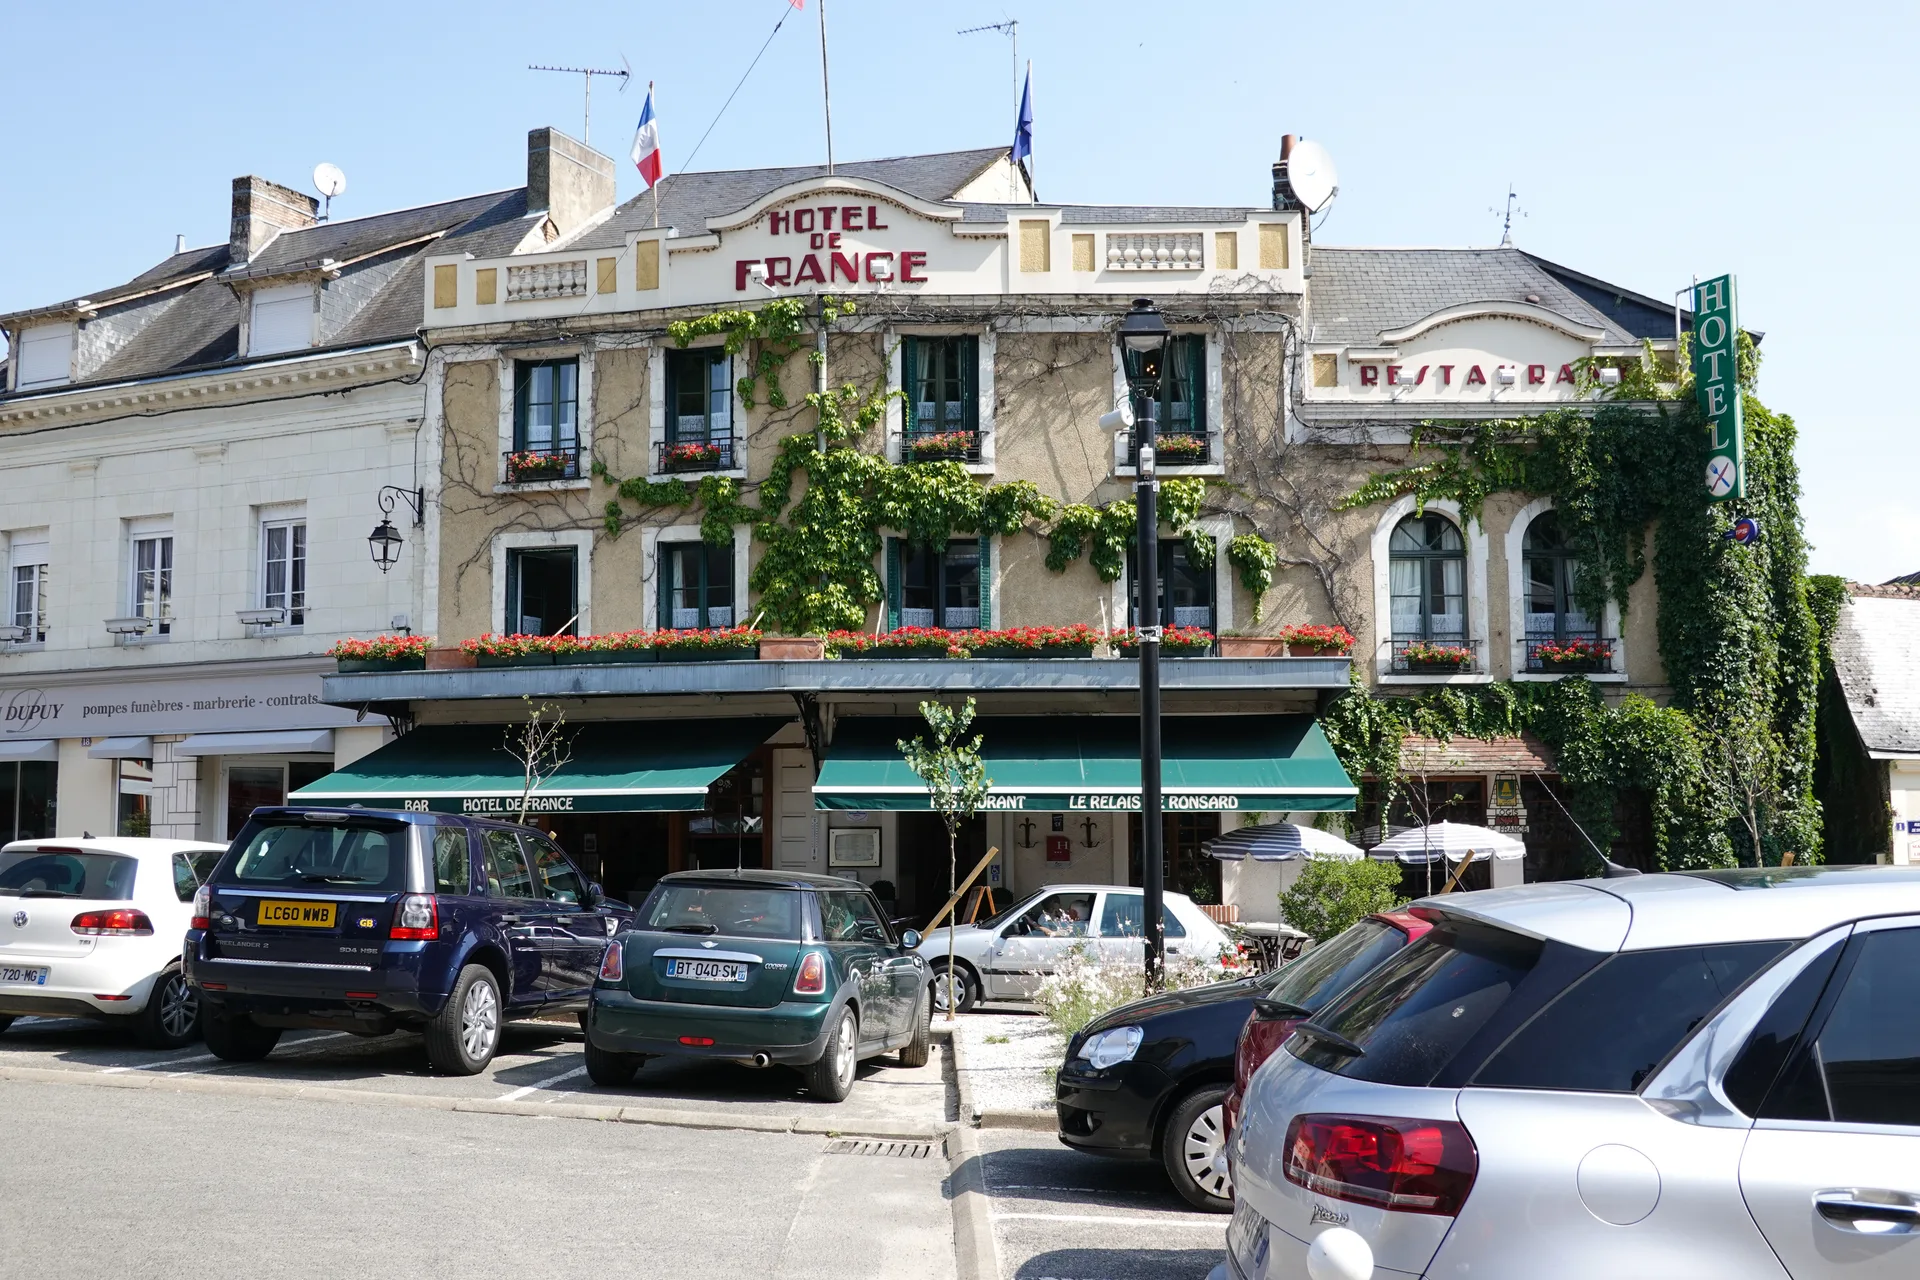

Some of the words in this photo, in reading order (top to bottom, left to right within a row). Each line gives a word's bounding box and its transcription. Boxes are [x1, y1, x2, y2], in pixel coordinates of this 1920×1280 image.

[770, 205, 889, 236] HOTEL
[810, 232, 842, 250] DE
[735, 251, 929, 291] FRANCE
[1697, 279, 1730, 451] HOTEL
[1360, 363, 1631, 387] RESTARA
[5, 703, 65, 721] DUPUY
[83, 703, 128, 719] pompes
[131, 700, 183, 713] funèbres
[193, 695, 256, 711] marbrerie
[266, 693, 319, 707] contrats
[82, 738, 91, 746] 18
[405, 799, 429, 812] BAR
[463, 798, 503, 812] HOTEL
[506, 798, 522, 811] DE
[525, 798, 574, 811] FRANCE
[1069, 795, 1087, 809] LE
[1090, 795, 1142, 809] RELAIS
[1169, 795, 1238, 809] RONSARD
[1057, 841, 1068, 850] H
[264, 906, 300, 921] LC60
[303, 907, 329, 922] WWB
[359, 919, 373, 928] GB
[216, 939, 261, 948] FREELANDER
[764, 962, 788, 971] COOPER
[1310, 1203, 1350, 1226] Picasso
